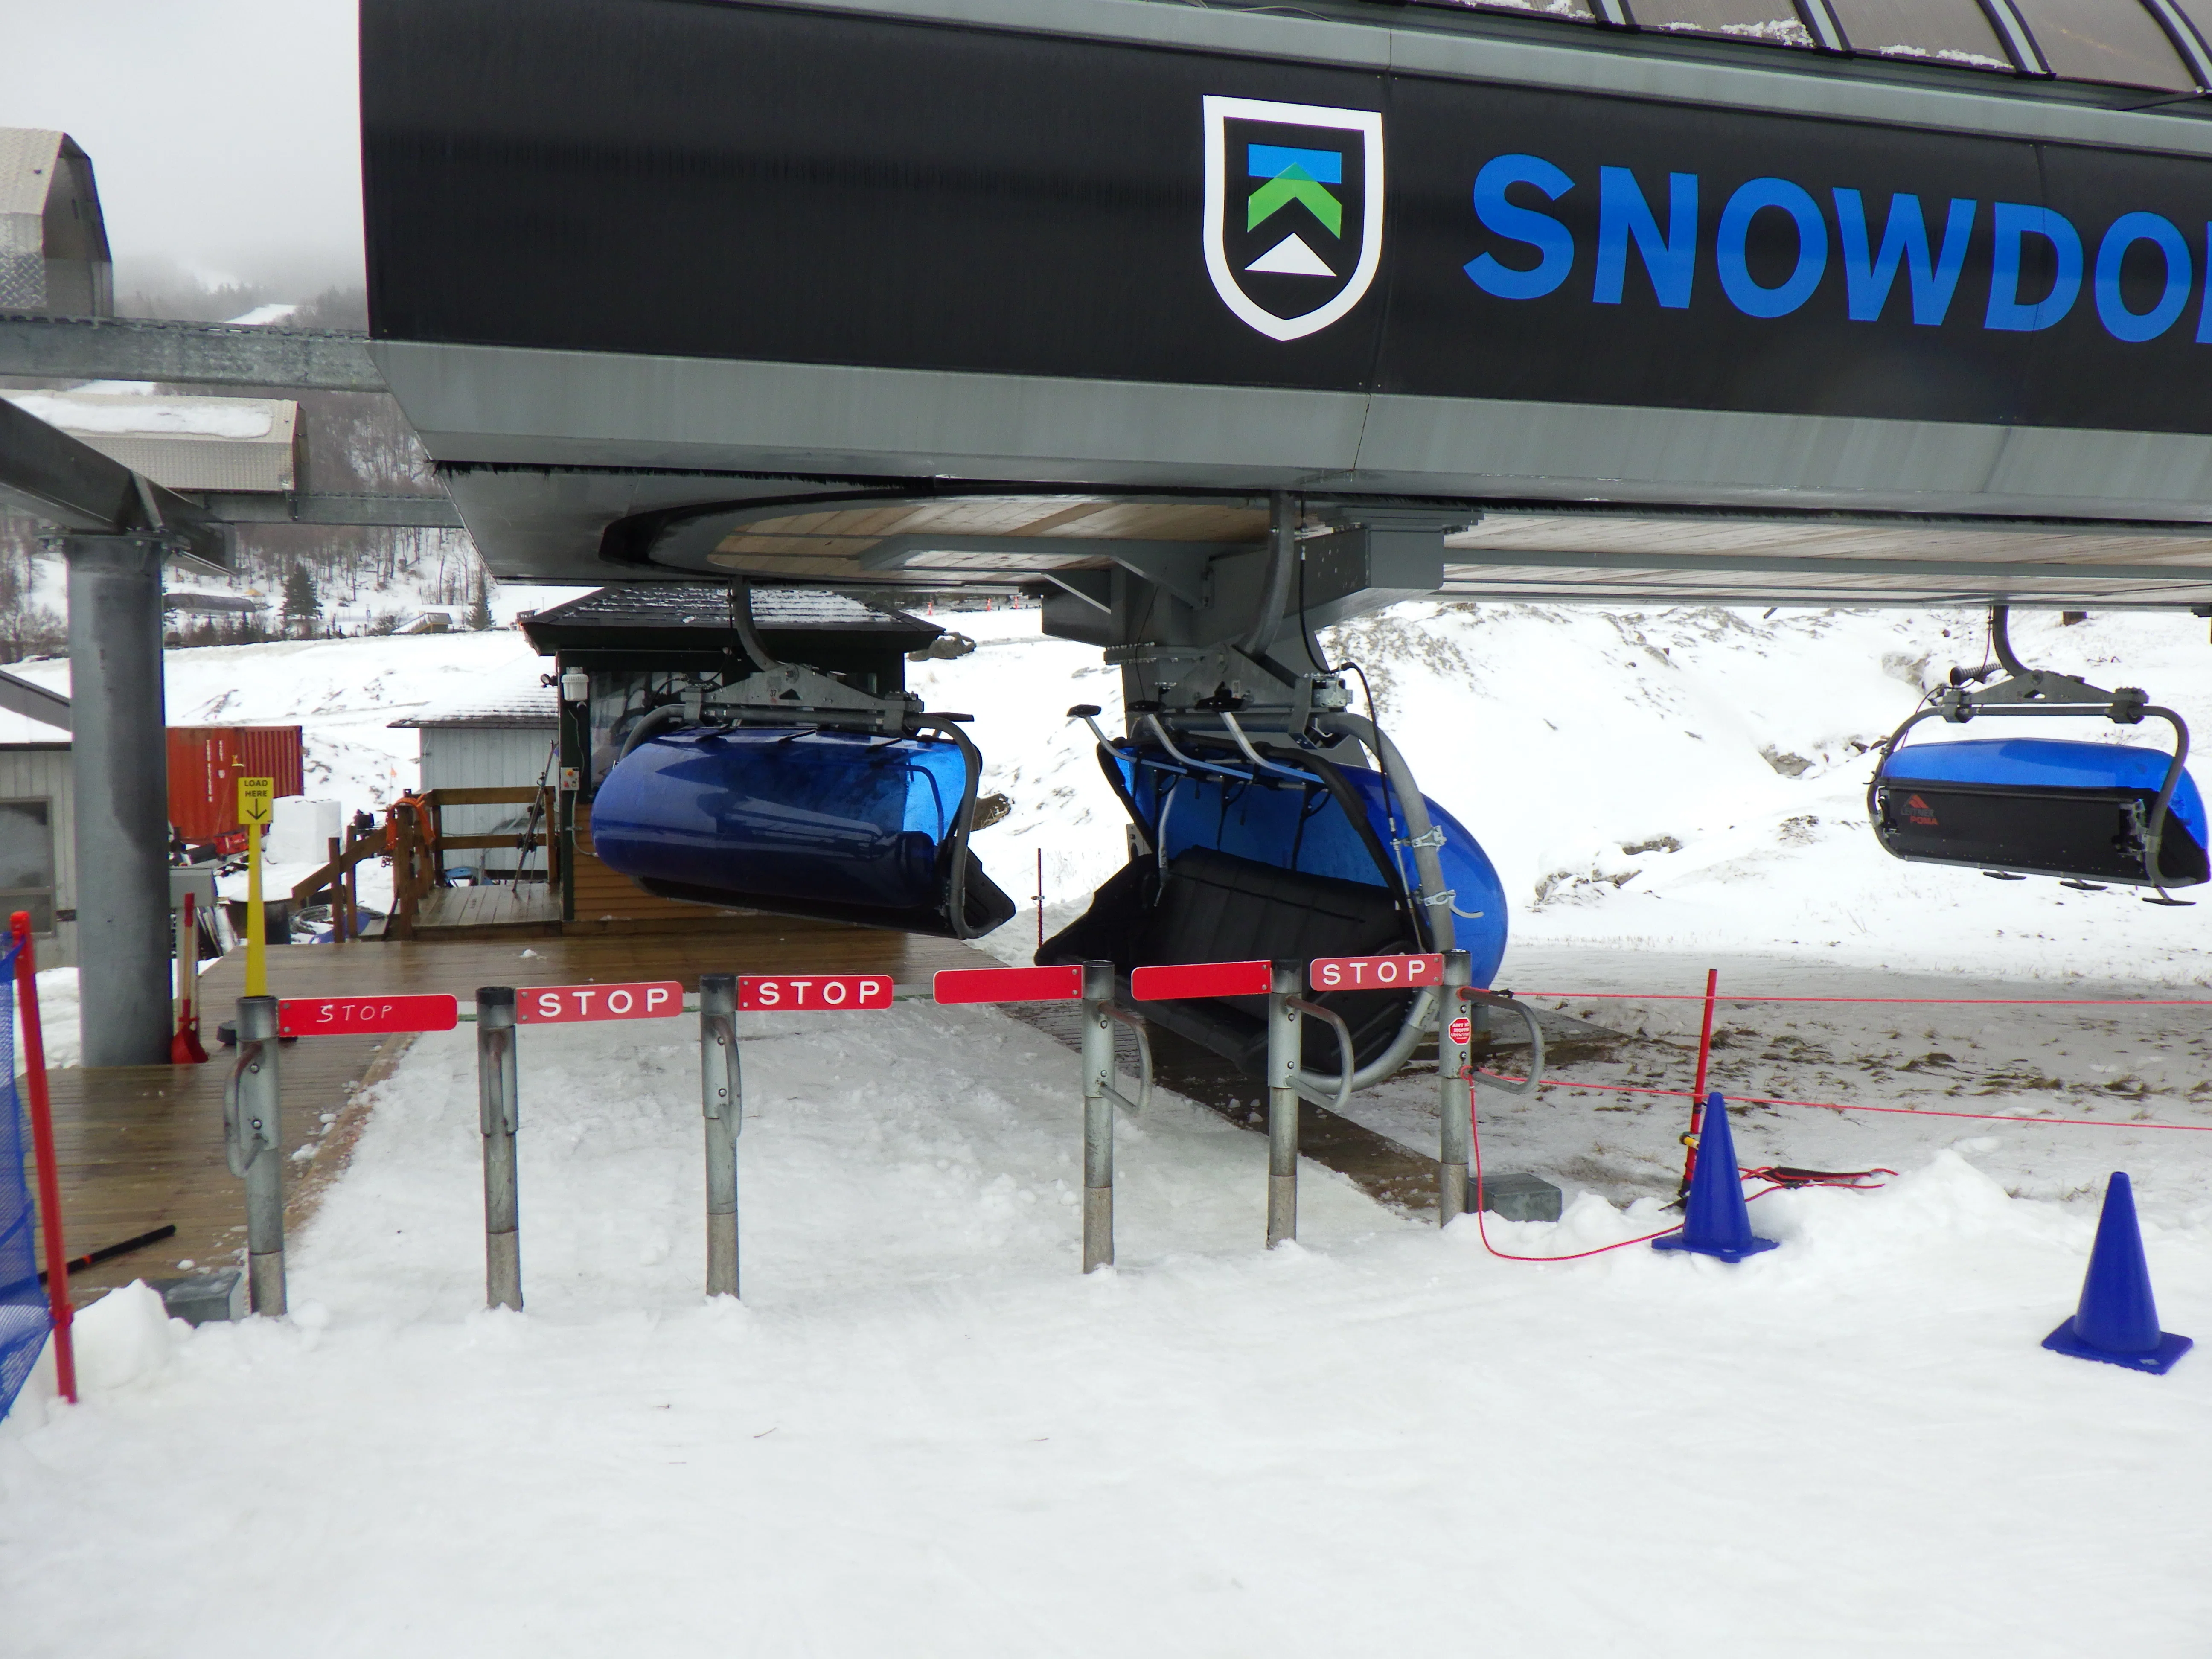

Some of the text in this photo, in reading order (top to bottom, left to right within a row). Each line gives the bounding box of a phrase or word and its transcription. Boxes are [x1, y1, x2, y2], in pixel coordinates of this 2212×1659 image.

[1910, 815, 1939, 826] POMA
[1324, 960, 1425, 985] STOP
[539, 989, 668, 1016] STOP
[760, 982, 879, 1004] STOP
[317, 1005, 392, 1022] STOP
